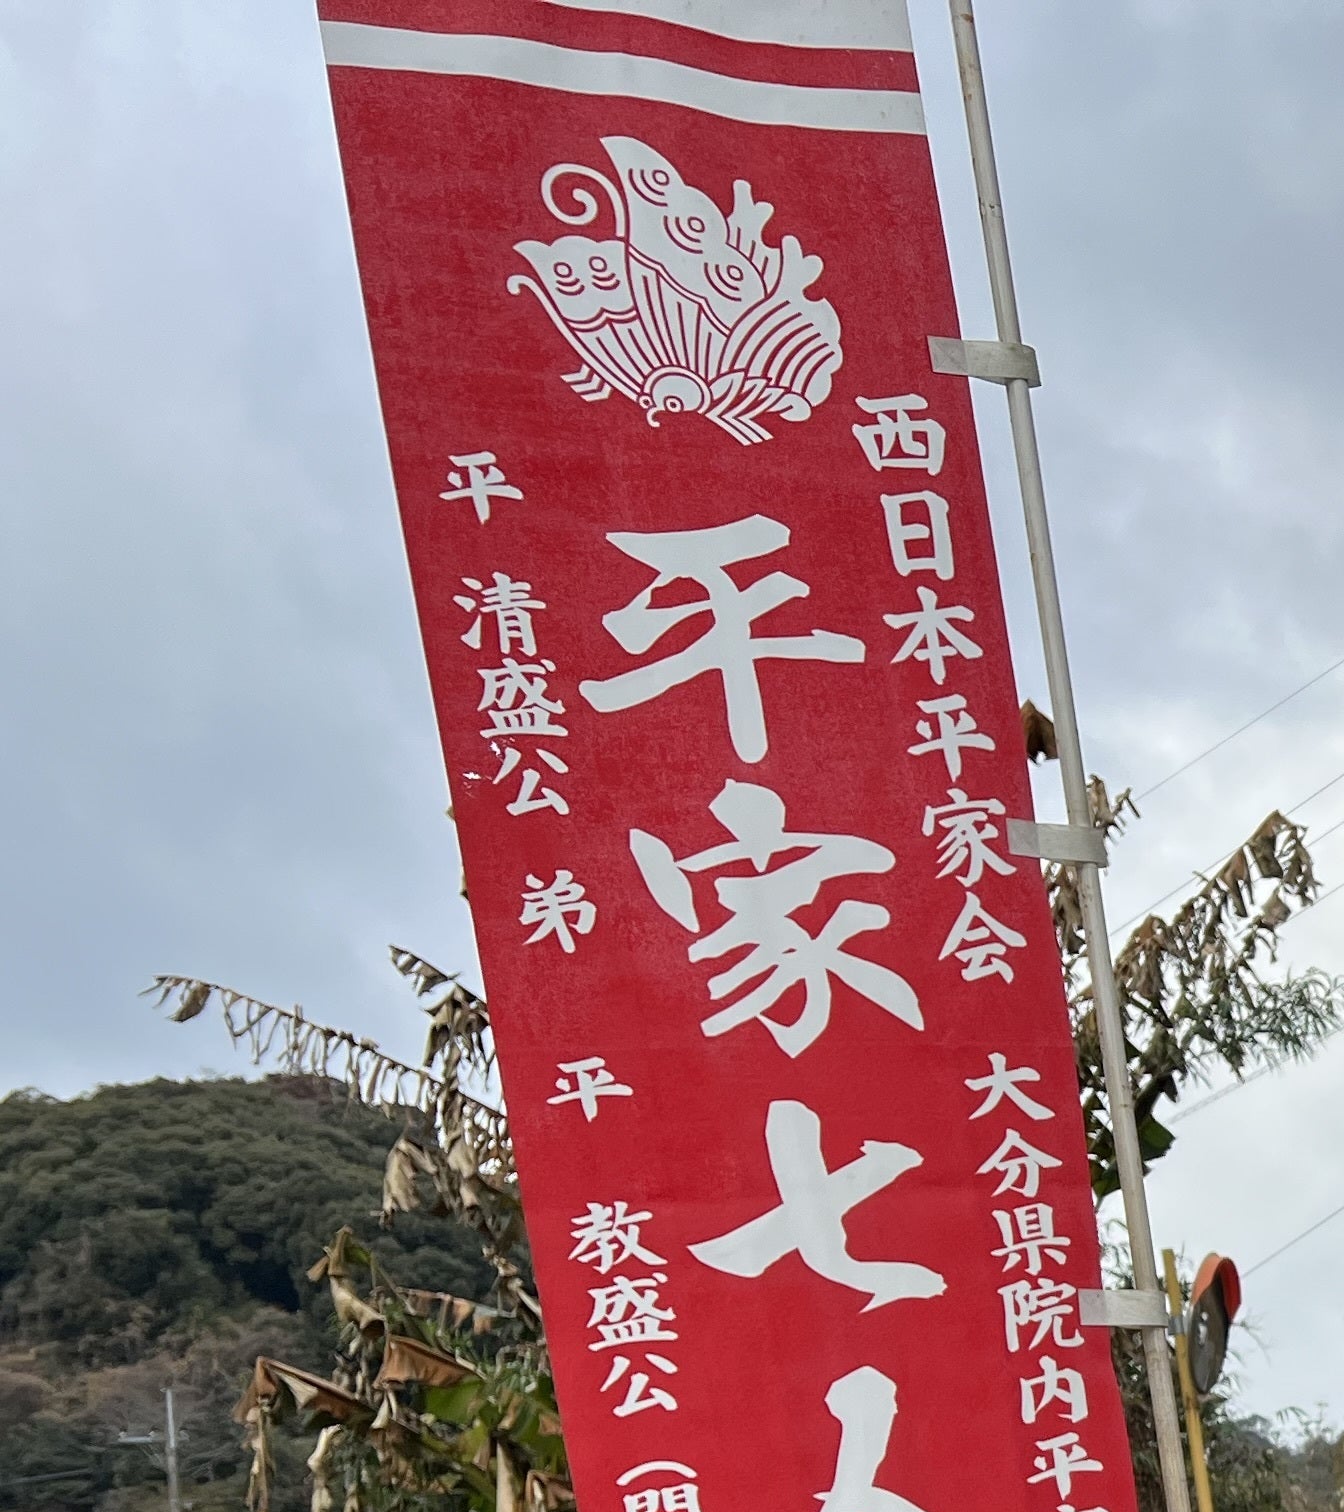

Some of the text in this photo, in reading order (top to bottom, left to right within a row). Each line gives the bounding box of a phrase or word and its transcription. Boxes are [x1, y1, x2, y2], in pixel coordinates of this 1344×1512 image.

[439, 451, 524, 524] 平
[453, 572, 570, 816] 清盛公
[852, 394, 1027, 983] 西日本平家会
[519, 870, 597, 954] 弟
[547, 1057, 634, 1122] 平
